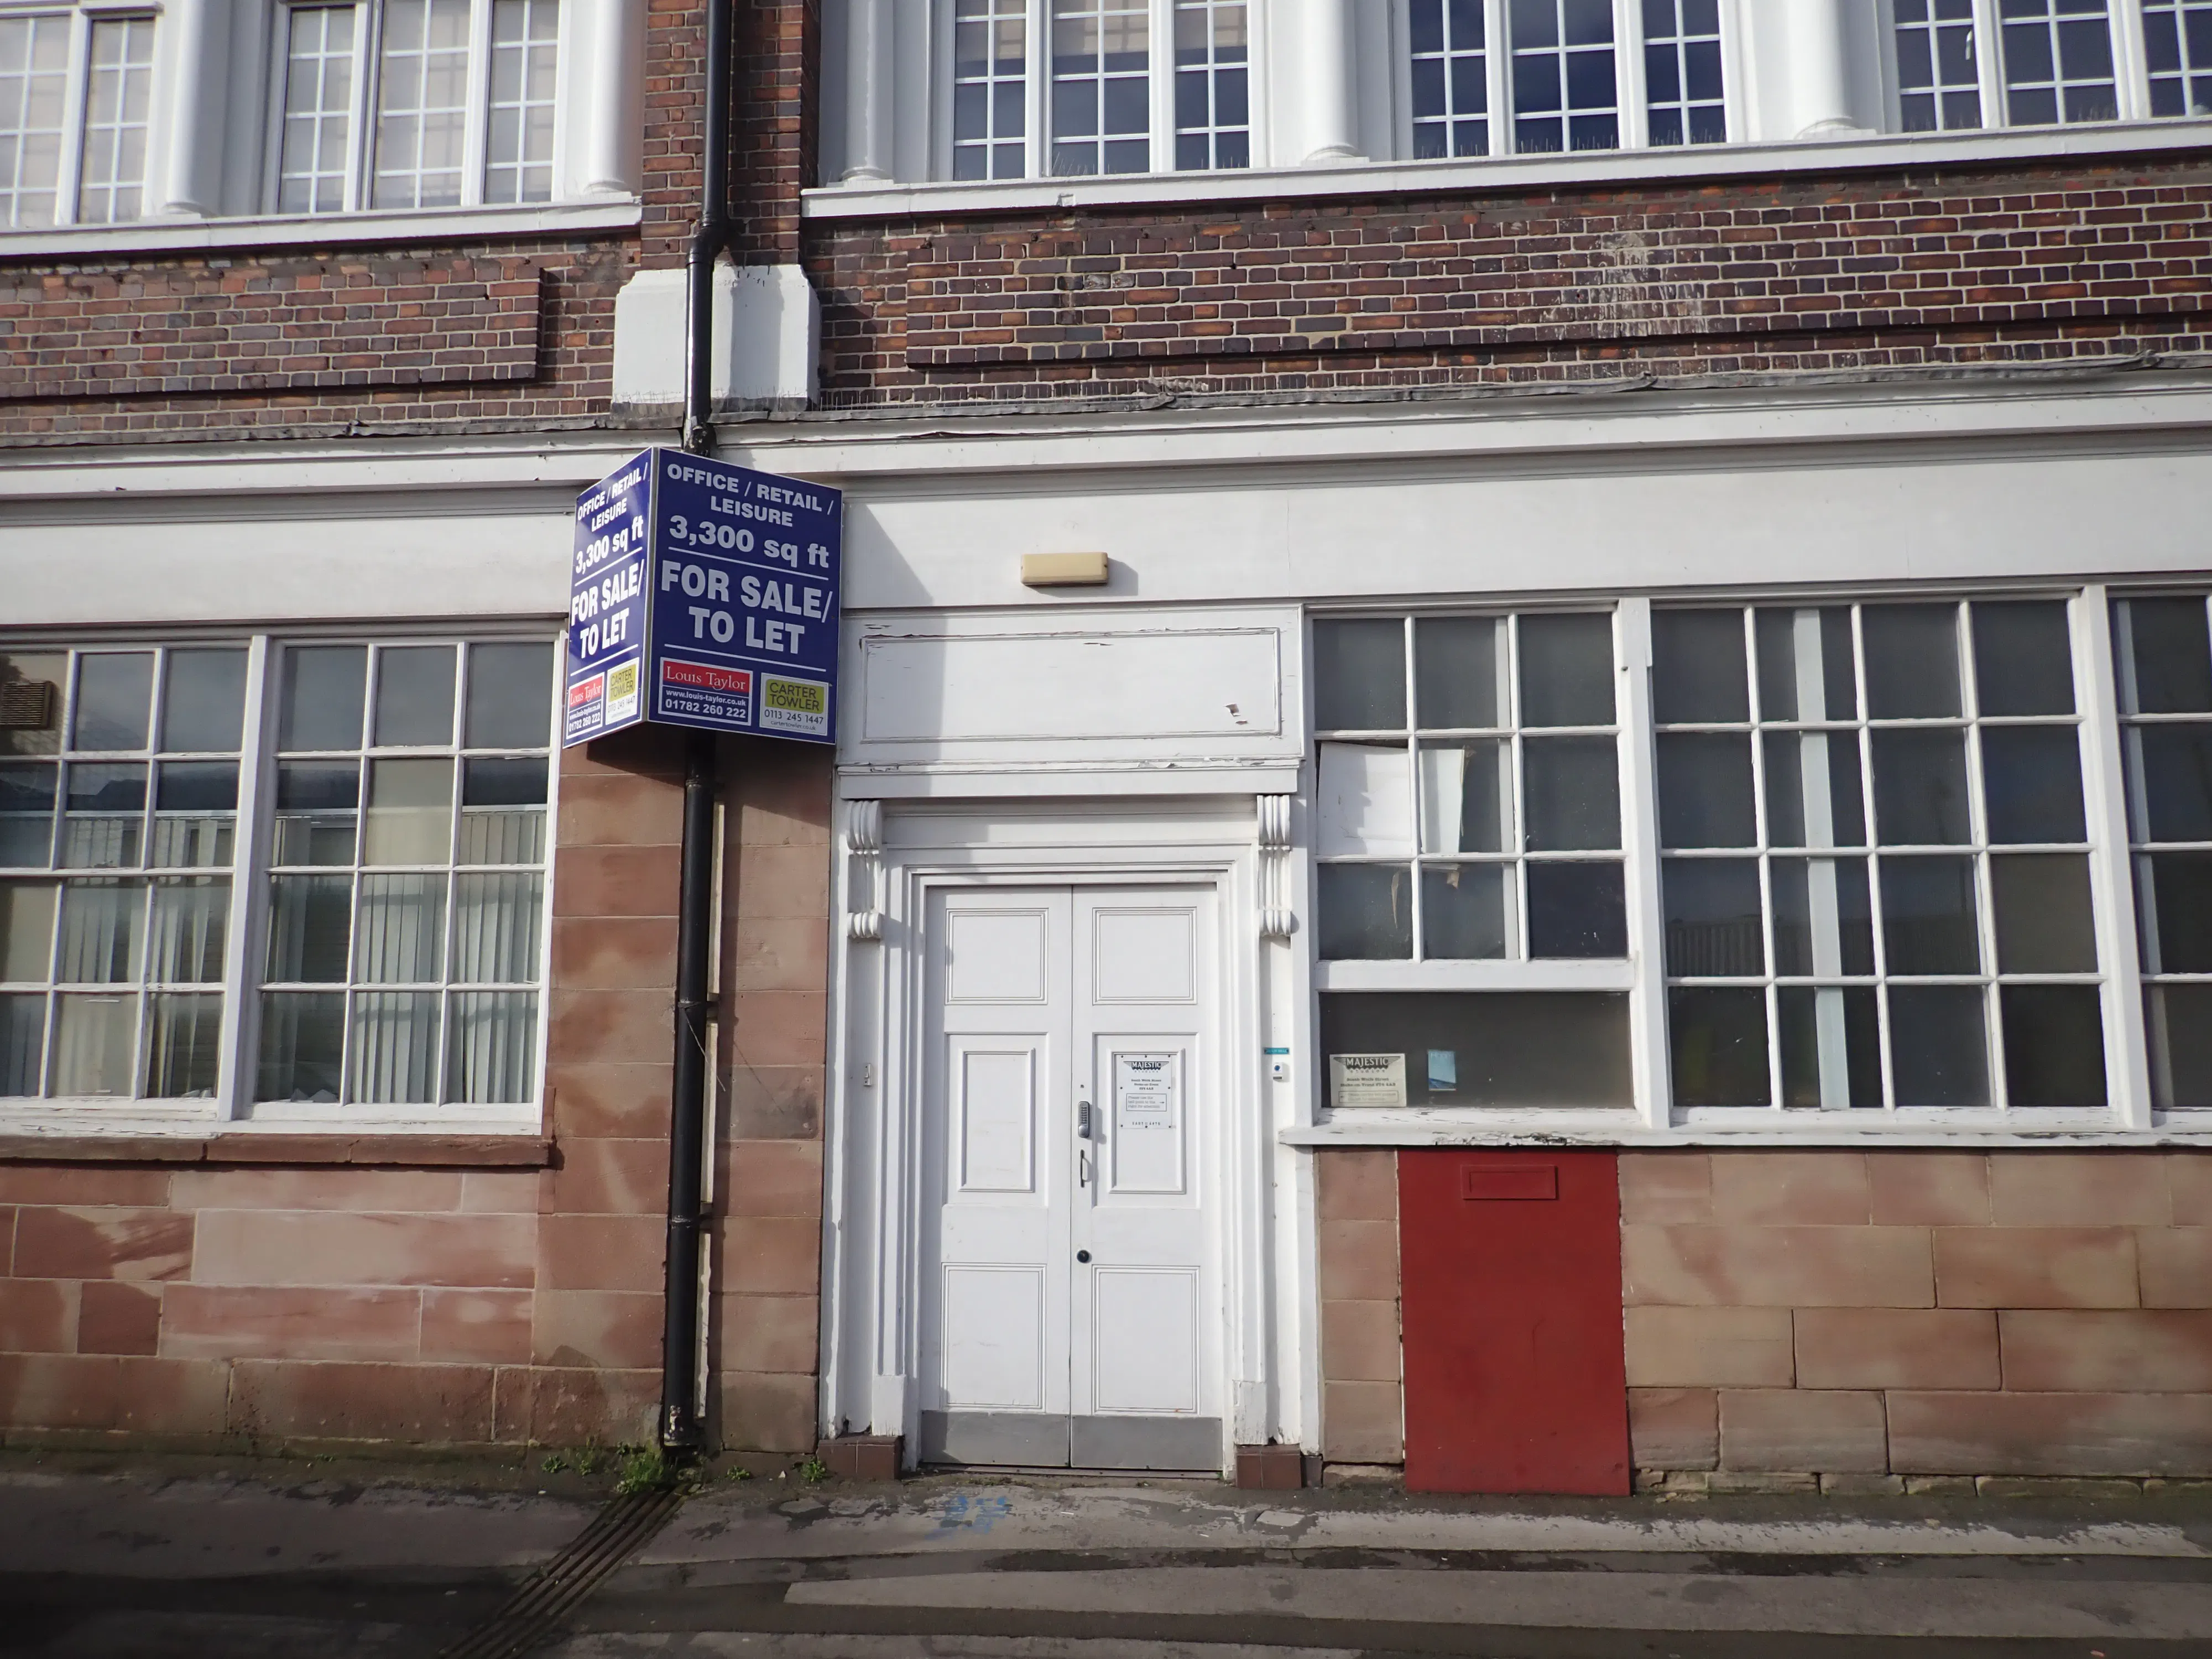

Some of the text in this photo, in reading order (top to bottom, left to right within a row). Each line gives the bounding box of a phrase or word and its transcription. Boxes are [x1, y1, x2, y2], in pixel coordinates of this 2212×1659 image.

[578, 492, 605, 520] OFFICE
[612, 468, 641, 499] RETAIL
[667, 463, 738, 493] OFFICE
[757, 484, 822, 512] RETAIL
[592, 498, 627, 532] LEISURE
[711, 496, 792, 527] LEISURE
[576, 515, 643, 575] 3,300 sq ft
[670, 515, 829, 568] 3,300 sq ft
[662, 560, 730, 602] FOR
[571, 586, 598, 627] FOR
[580, 608, 629, 659] TO LET
[688, 606, 805, 654] TO LET
[611, 668, 632, 686] CARTER
[611, 681, 634, 697] TOWLER
[666, 666, 745, 691] Louis Taylor
[570, 684, 601, 705] Louis Taylor
[666, 690, 746, 706] www.louis-taylor.co.uk
[769, 682, 816, 699] CARTER
[770, 694, 820, 711] TOWLER
[665, 698, 746, 718] 01782 260 222
[764, 709, 823, 724] 0113 245 1447
[770, 720, 816, 731] cartertowler.co.uk
[1347, 1057, 1388, 1067] MAJESTIC
